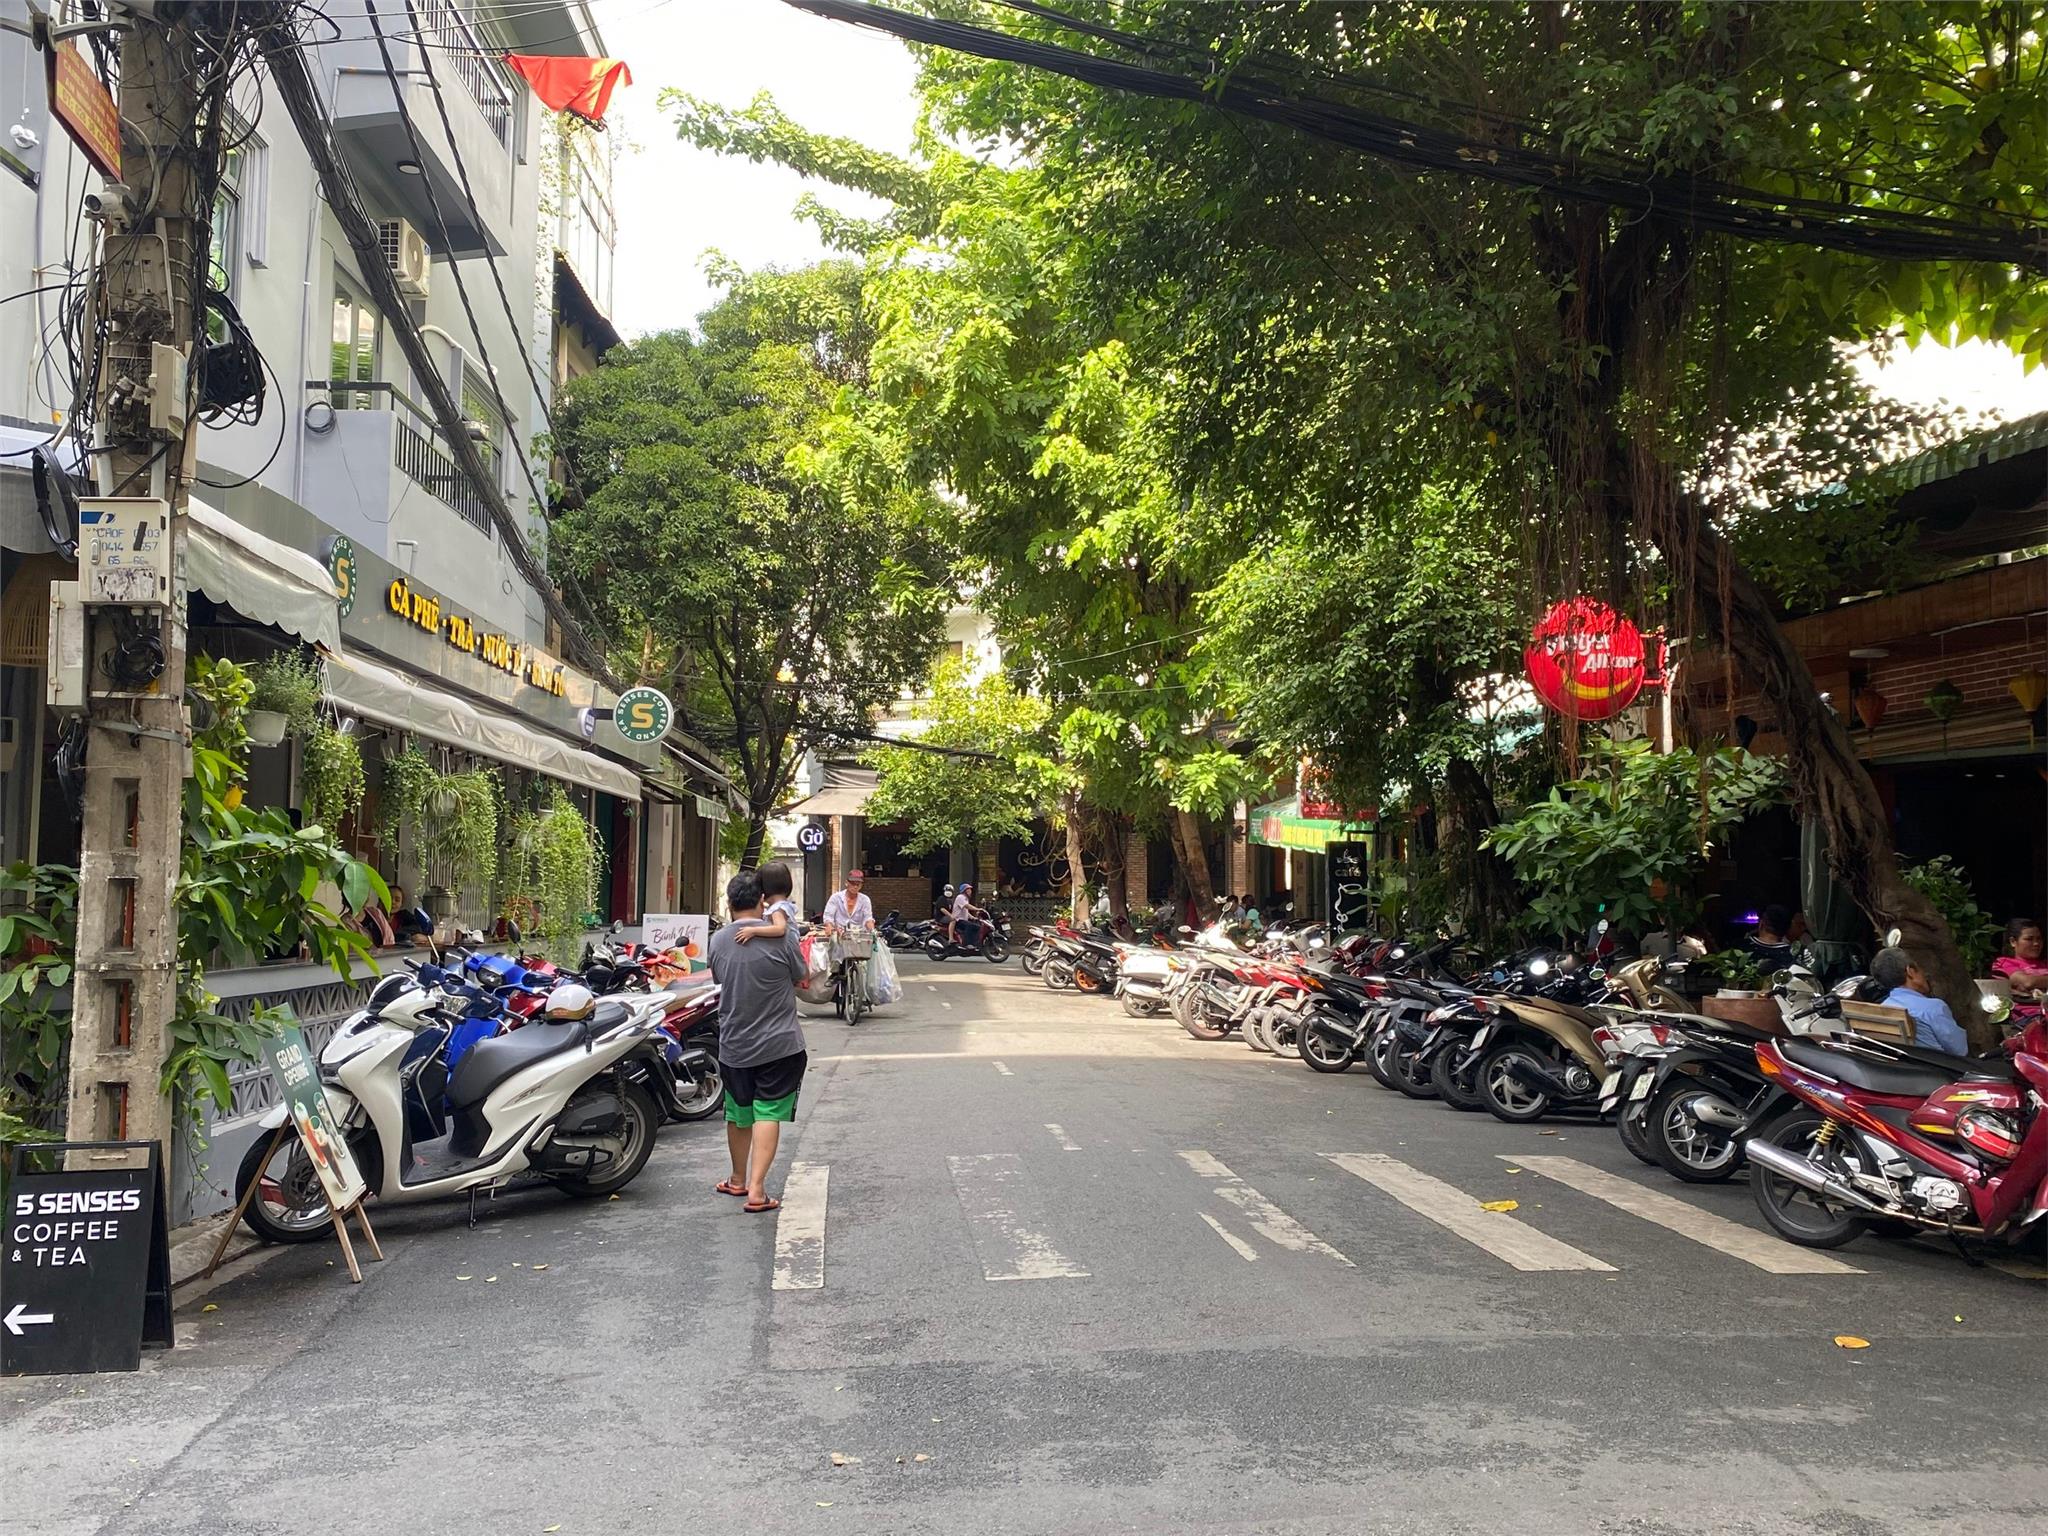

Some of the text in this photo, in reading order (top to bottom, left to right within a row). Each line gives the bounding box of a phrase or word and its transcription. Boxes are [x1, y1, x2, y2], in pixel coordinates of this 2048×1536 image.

[389, 577, 410, 619] CÀ
[412, 595, 440, 634] PHÊ
[449, 614, 475, 653] TRÀ
[617, 691, 649, 715] SENSES
[652, 695, 668, 730] COFFEE
[618, 719, 632, 737] TEA
[630, 703, 654, 729] S
[635, 730, 656, 740] AND
[276, 1044, 303, 1070] GRAND
[16, 1189, 141, 1216] 5 SENSES
[13, 1220, 119, 1243] COFFEE
[11, 1246, 87, 1267] & TEA
